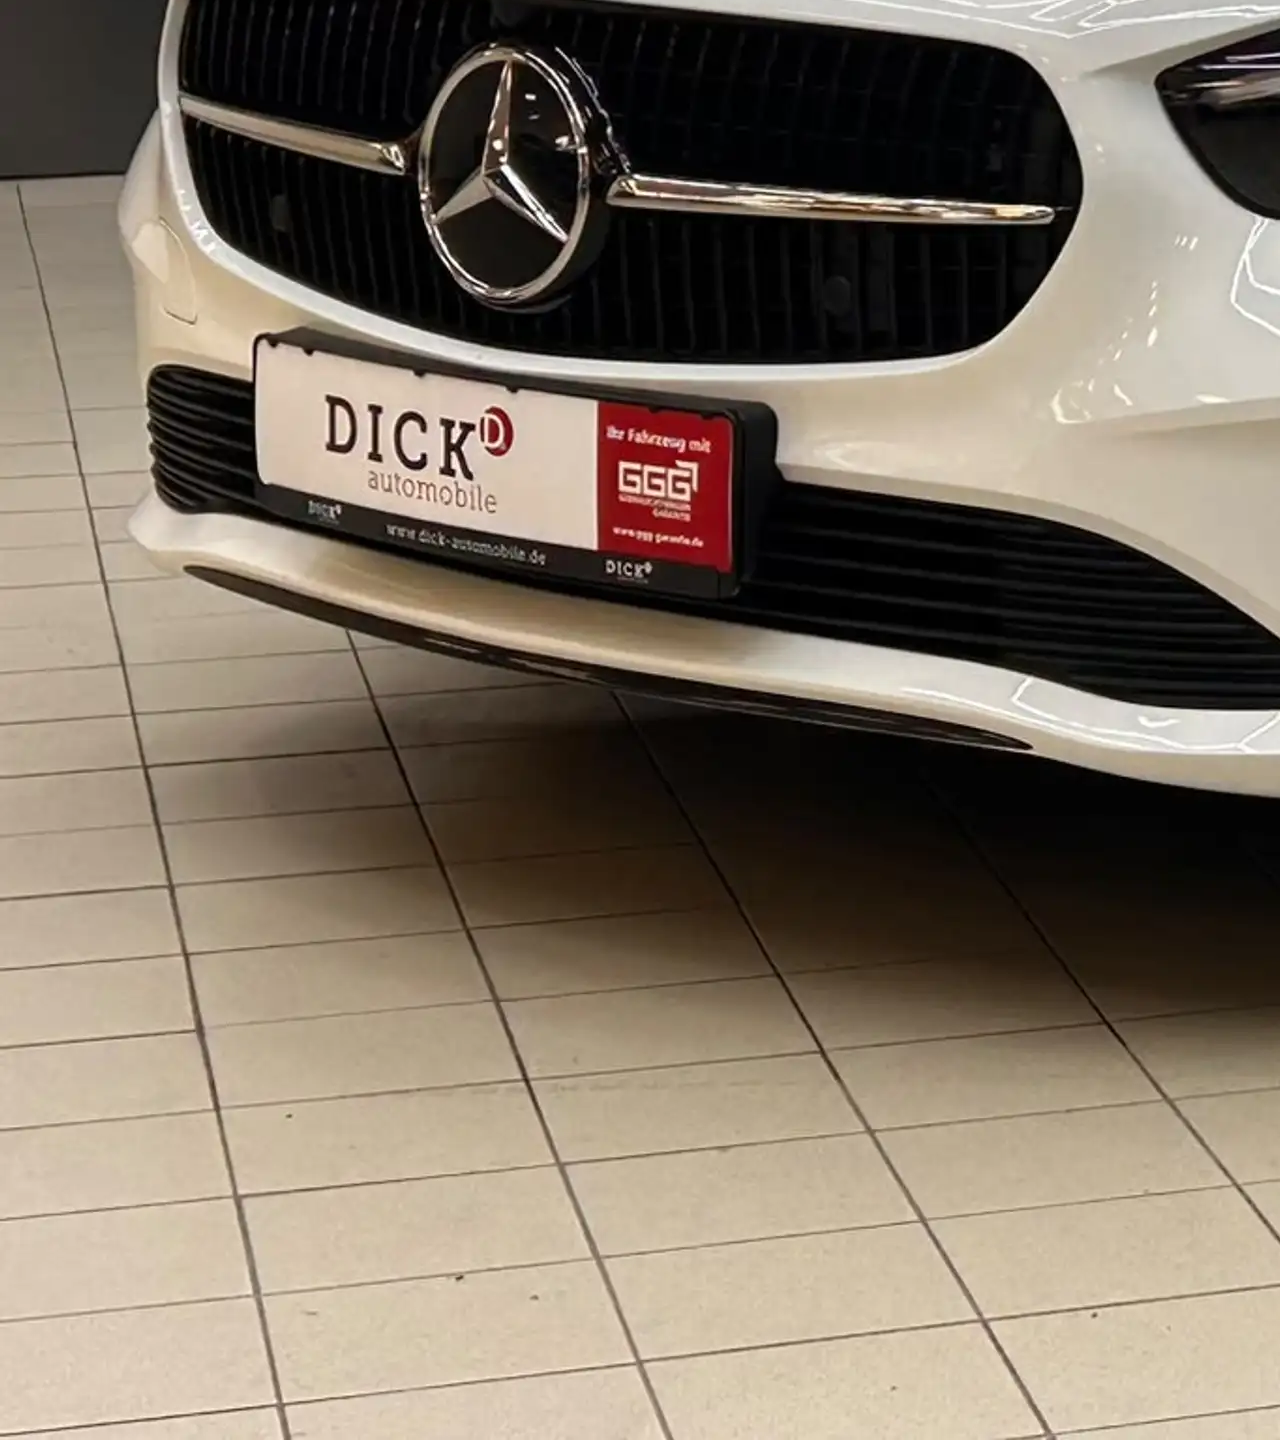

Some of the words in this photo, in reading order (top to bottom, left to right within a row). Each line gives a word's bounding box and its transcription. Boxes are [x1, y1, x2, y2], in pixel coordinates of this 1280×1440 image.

[325, 394, 476, 481] DICK
[628, 428, 686, 453] Fahrzeug
[689, 437, 711, 453] mit
[367, 470, 497, 514] automobile
[618, 460, 694, 501] GGG
[605, 560, 645, 578] DICK
